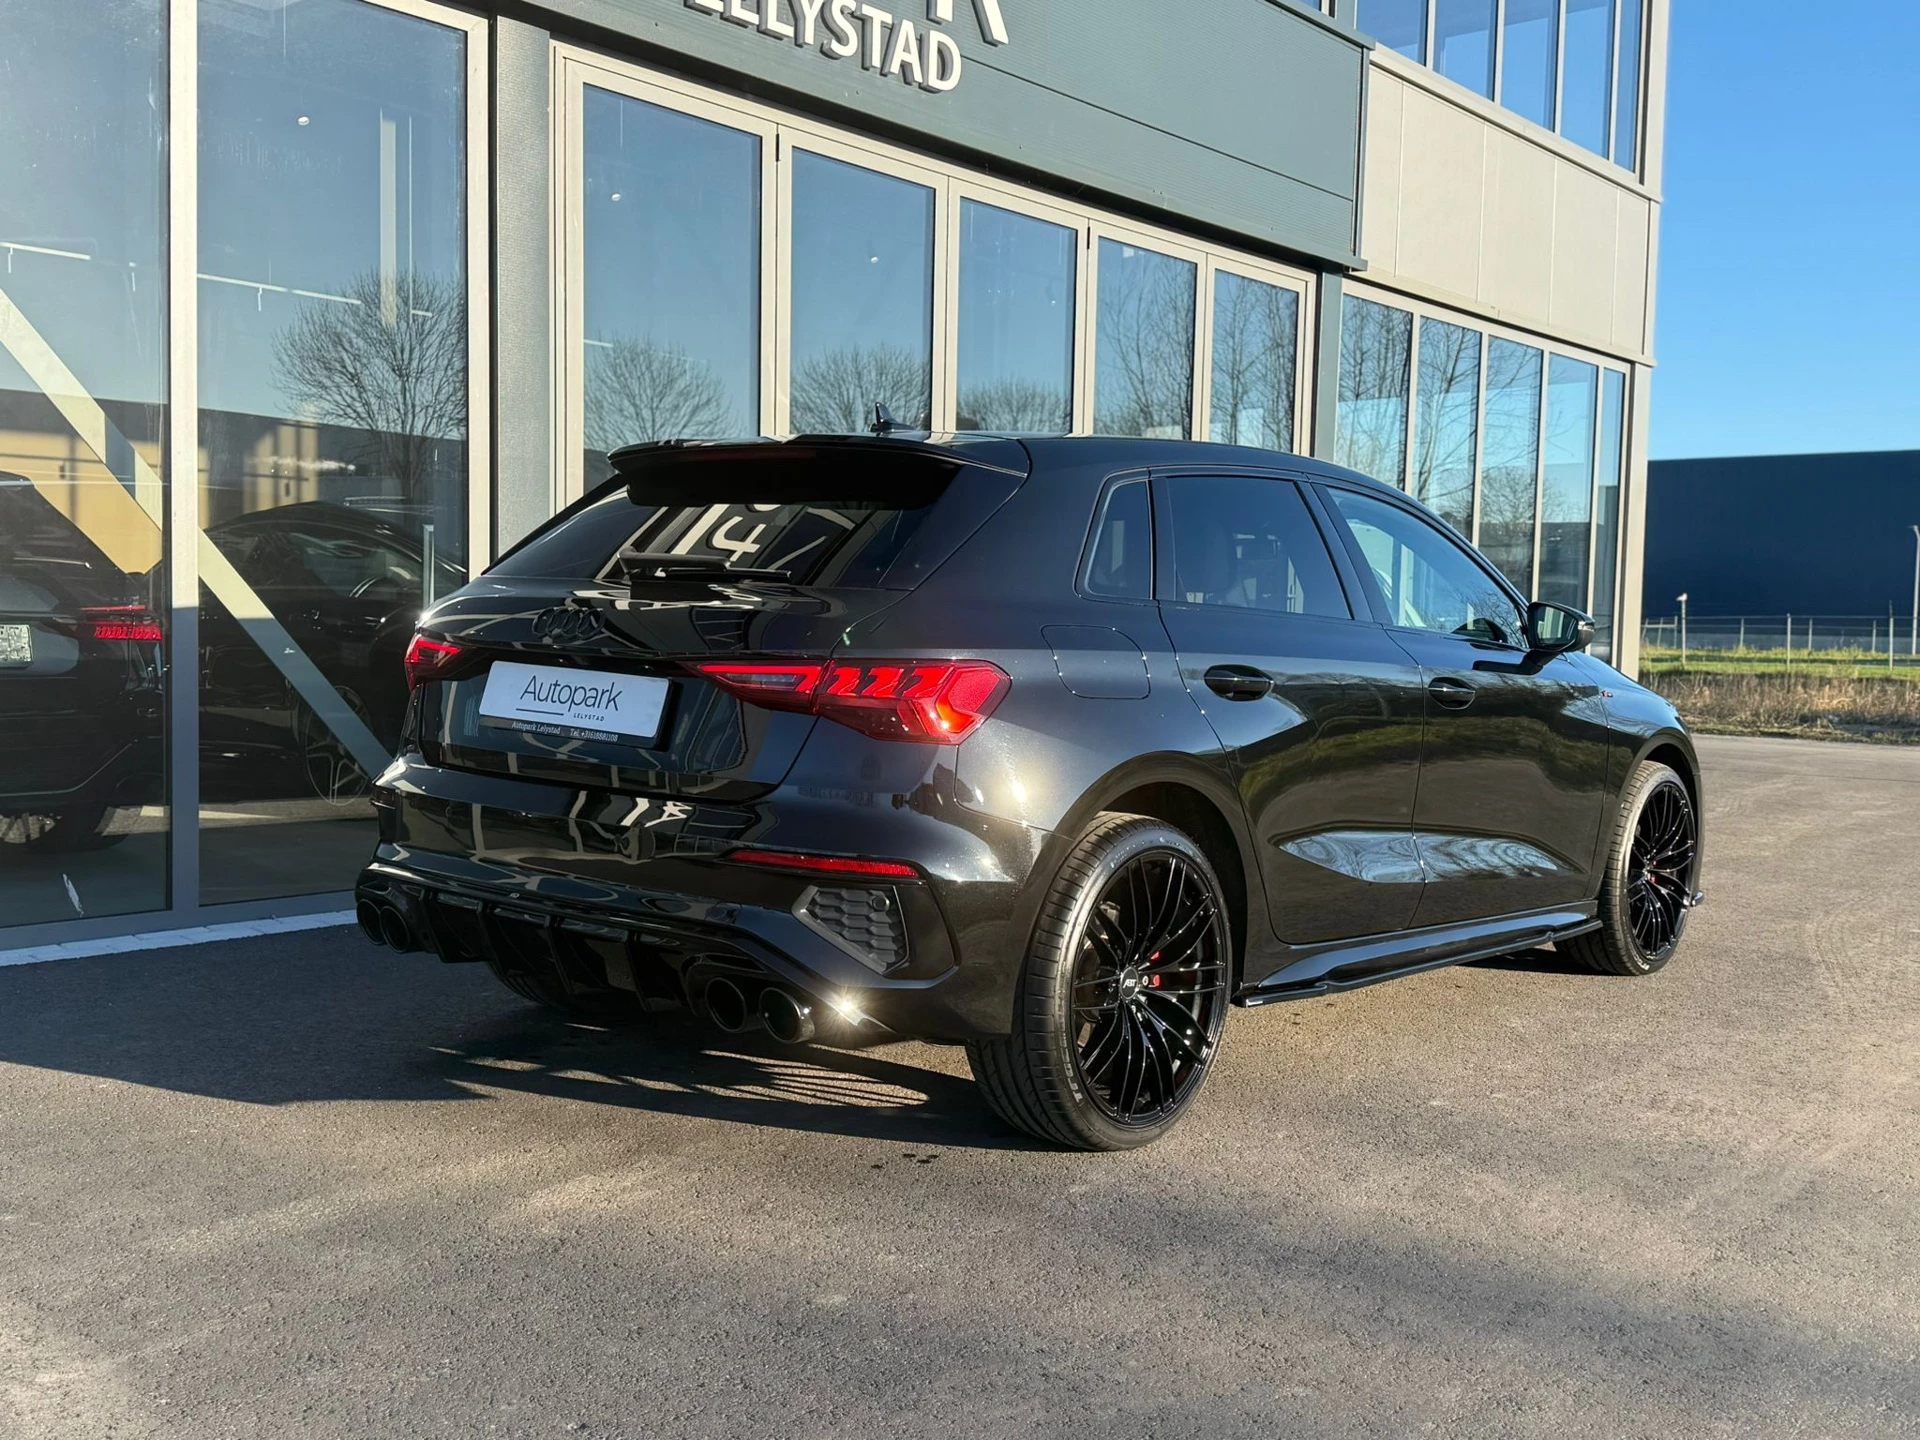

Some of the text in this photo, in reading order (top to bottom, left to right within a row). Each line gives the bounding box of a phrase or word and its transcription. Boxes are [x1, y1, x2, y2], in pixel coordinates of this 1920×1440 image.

[688, 0, 962, 92] LYSTAD
[519, 674, 623, 712] Autopark
[511, 721, 536, 731] Autopark
[536, 724, 561, 735] Lelystad
[573, 713, 605, 722] LELYSTAD
